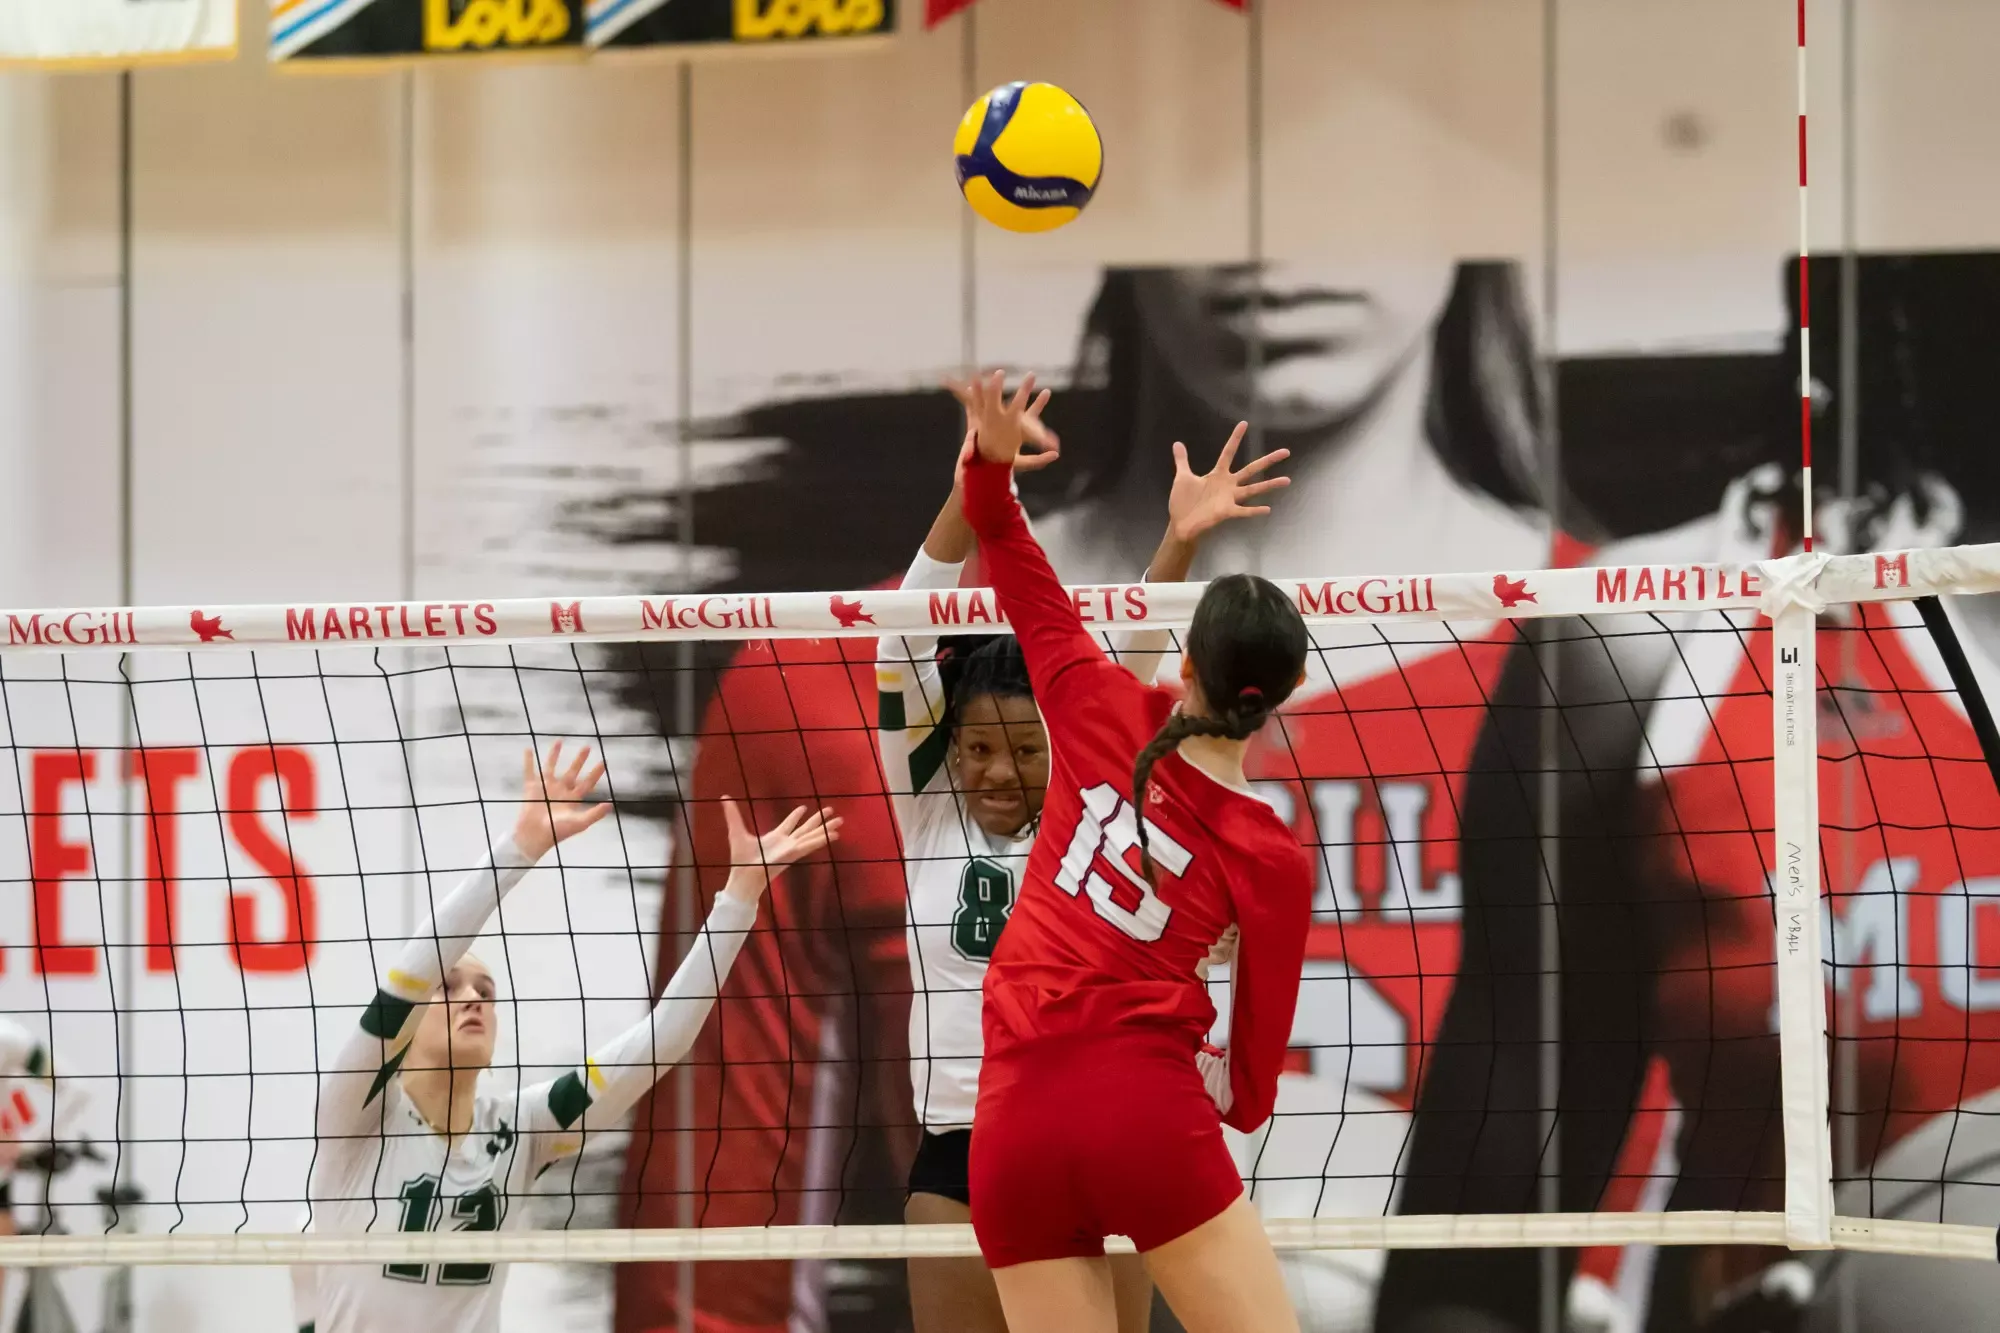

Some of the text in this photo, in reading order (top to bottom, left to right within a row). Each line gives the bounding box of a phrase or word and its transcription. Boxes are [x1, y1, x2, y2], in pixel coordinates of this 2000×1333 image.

[6, 612, 140, 646] McGill
[286, 603, 498, 641] MARTLETS
[640, 596, 778, 631] McGill
[929, 586, 1148, 625] MAETS
[1295, 577, 1438, 615] McGill
[1596, 565, 1762, 604] MARTLE
[0, 743, 318, 977] ETS
[951, 855, 1013, 963] 8
[1054, 781, 1194, 942] 15
[1785, 914, 1802, 956] VBALL
[382, 1172, 501, 1286] 12
